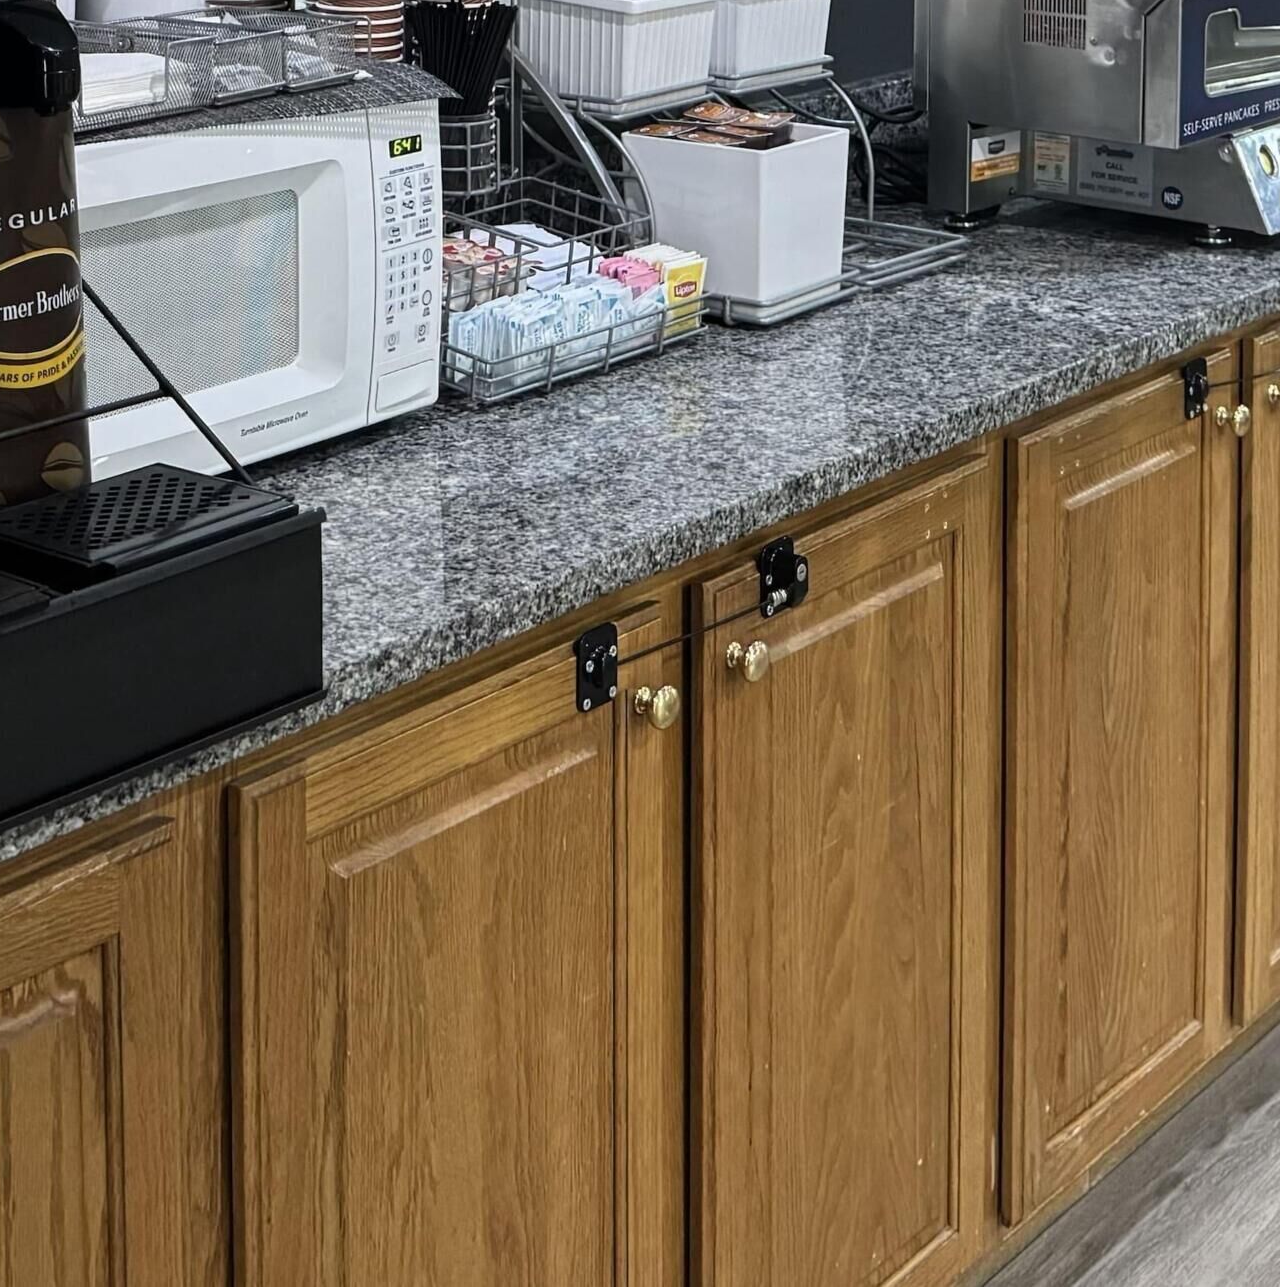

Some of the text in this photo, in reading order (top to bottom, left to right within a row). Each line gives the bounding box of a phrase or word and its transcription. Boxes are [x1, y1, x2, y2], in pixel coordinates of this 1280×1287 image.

[1183, 114, 1223, 136] SELF-SERVE
[1224, 103, 1260, 124] PANCAKES
[1163, 191, 1182, 205] NSF
[676, 281, 696, 296] Lipton
[36, 283, 80, 315] Brothers
[22, 372, 34, 382] OF
[37, 363, 60, 379] PRIDE
